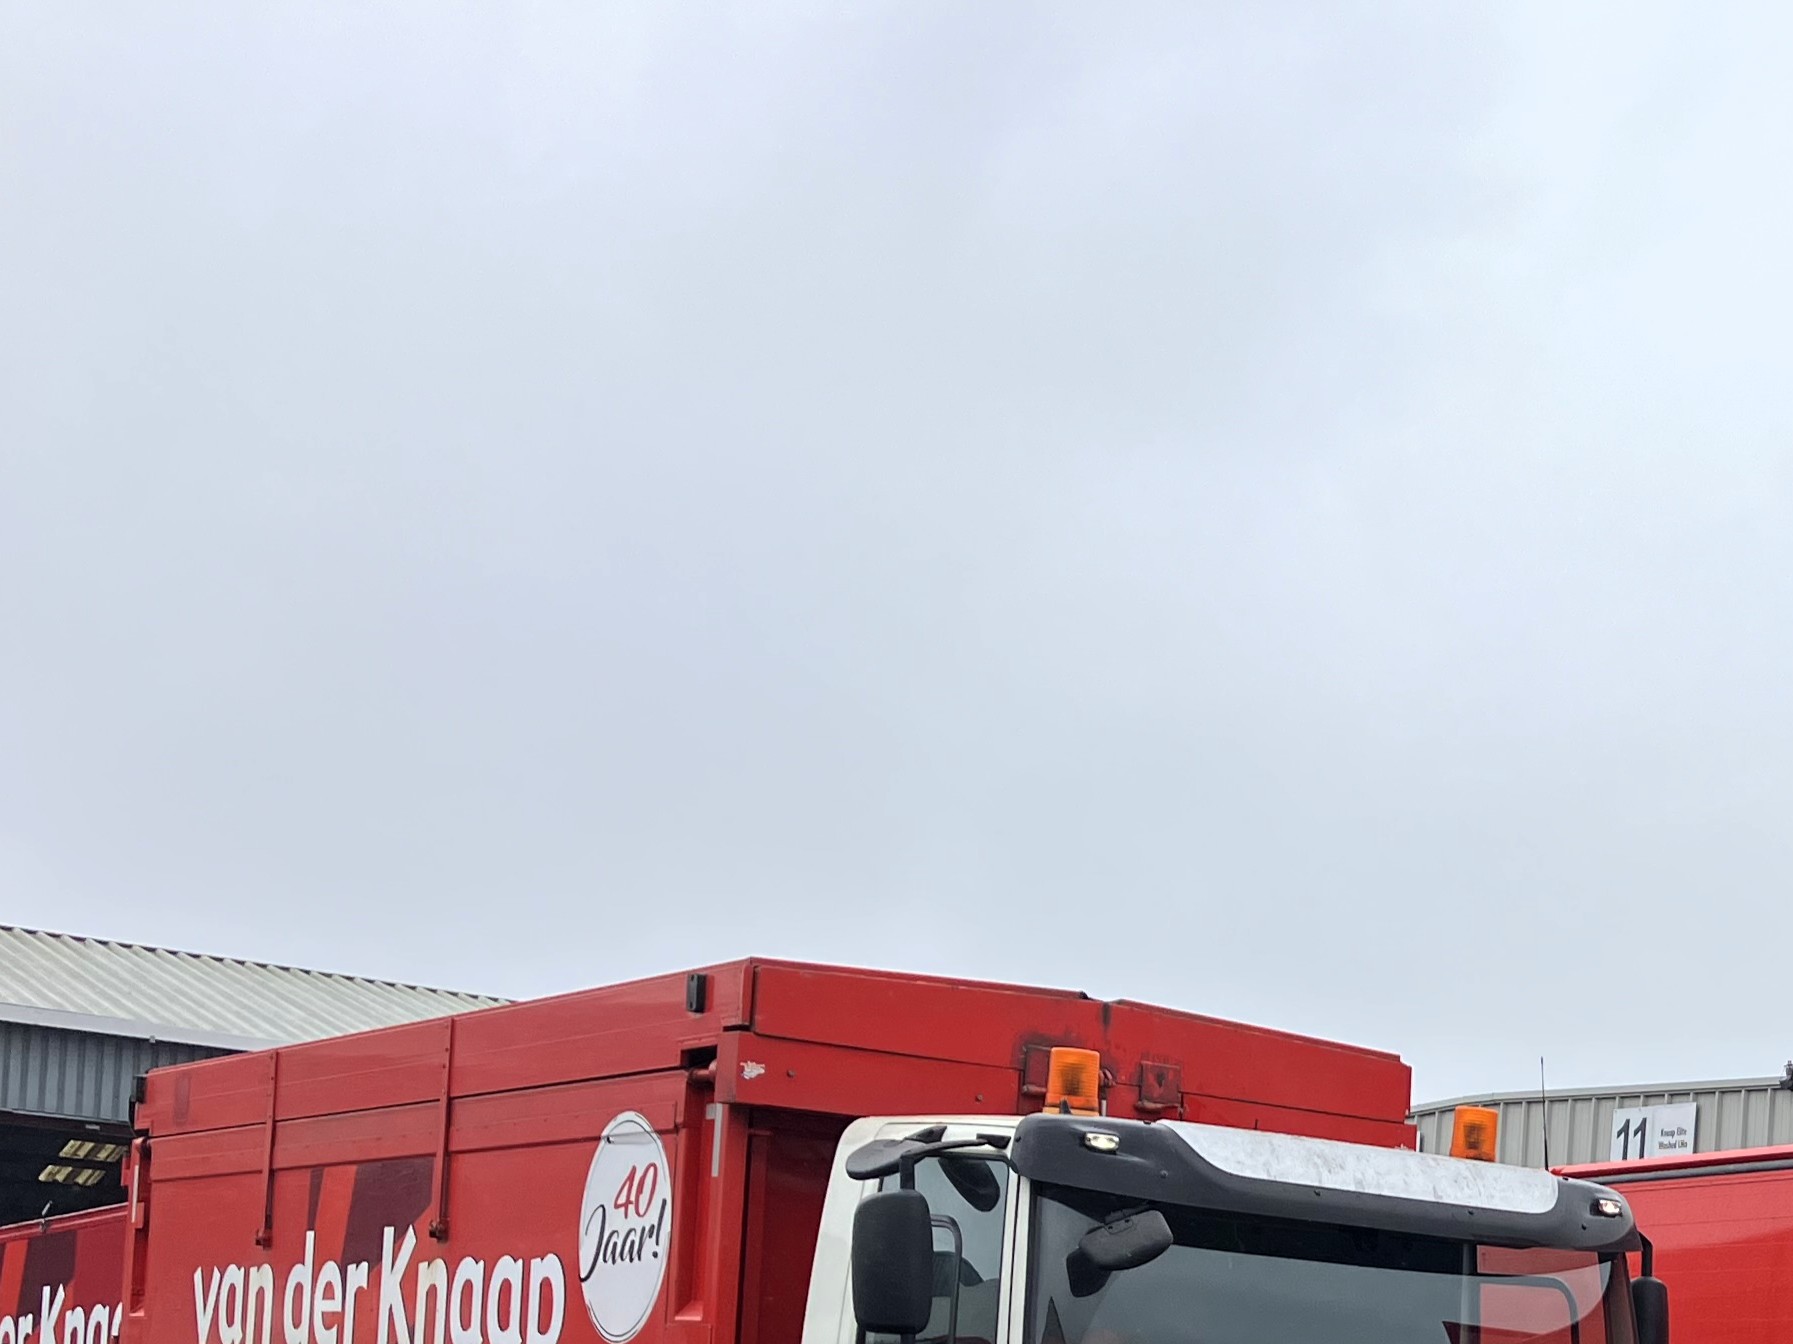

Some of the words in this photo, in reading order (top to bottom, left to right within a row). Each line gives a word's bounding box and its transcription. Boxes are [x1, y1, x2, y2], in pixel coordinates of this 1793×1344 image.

[1617, 1117, 1647, 1160] 11
[614, 1162, 658, 1219] 40
[578, 1198, 667, 1282] Jaar!
